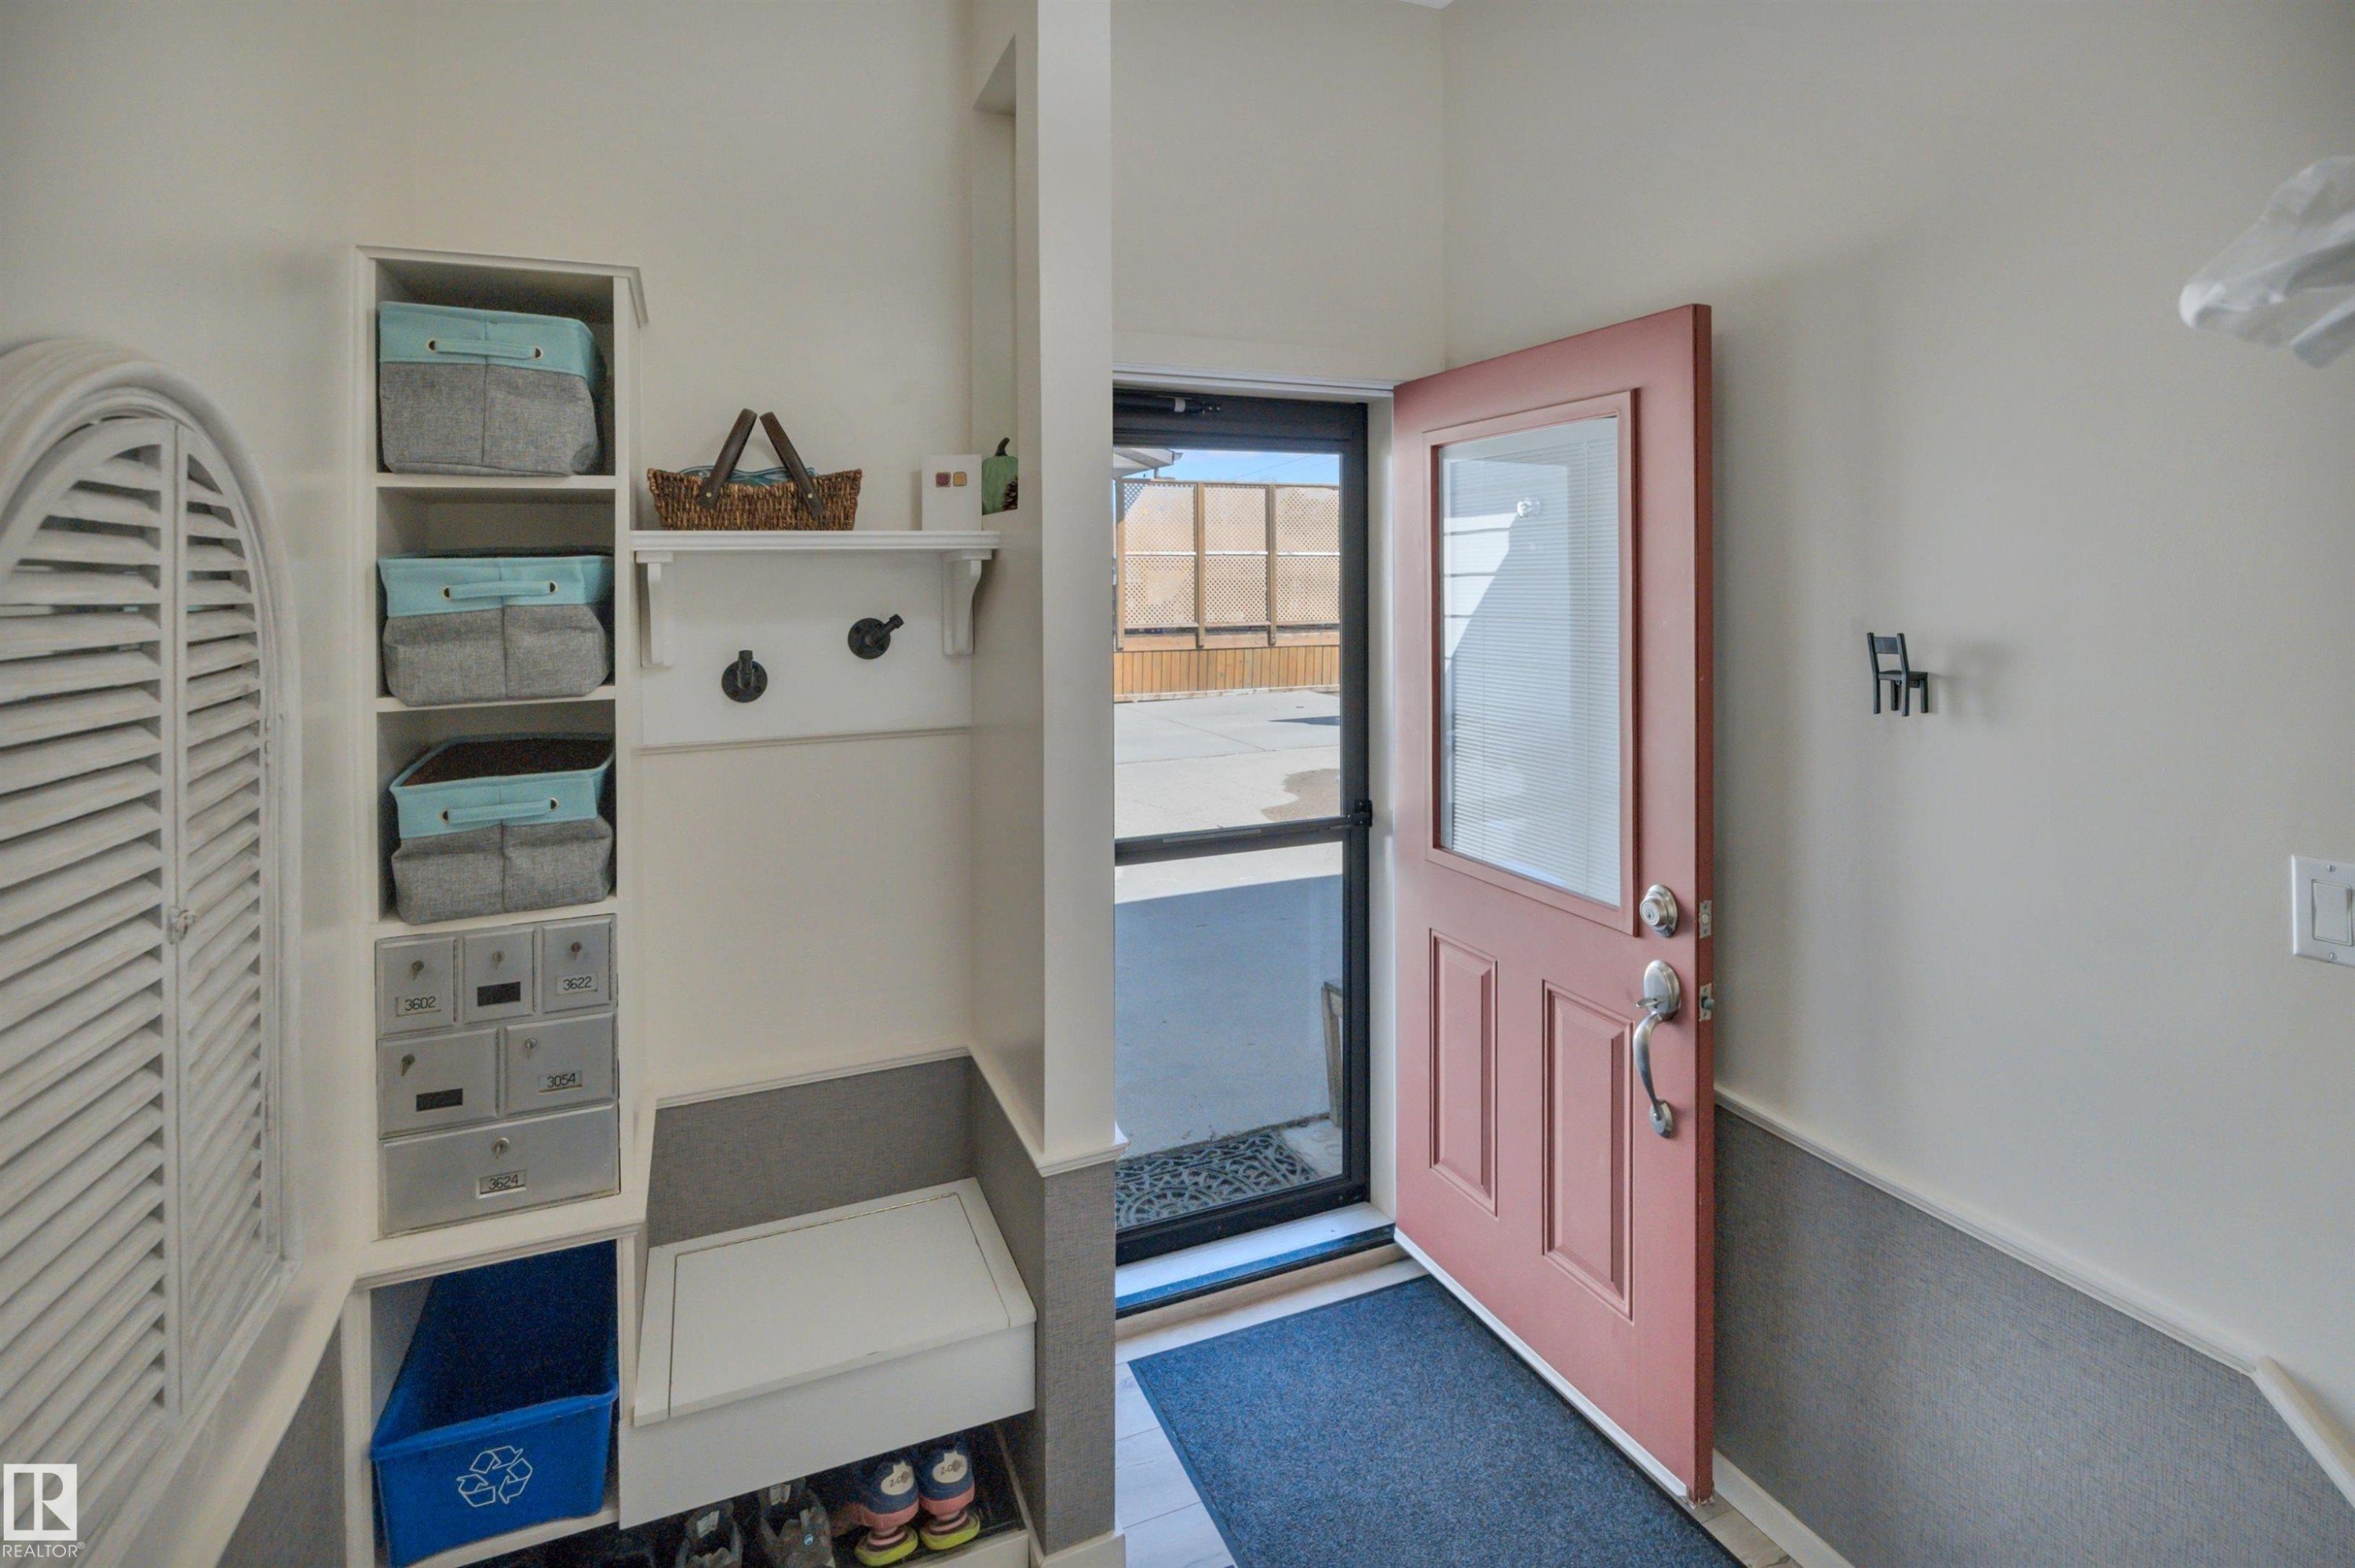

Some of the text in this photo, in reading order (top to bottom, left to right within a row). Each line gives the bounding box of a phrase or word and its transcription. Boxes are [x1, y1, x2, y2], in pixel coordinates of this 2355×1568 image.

[563, 975, 593, 991] 3622
[404, 996, 436, 1012] 3602
[547, 1073, 575, 1088] 3054
[489, 1174, 519, 1191] 3624
